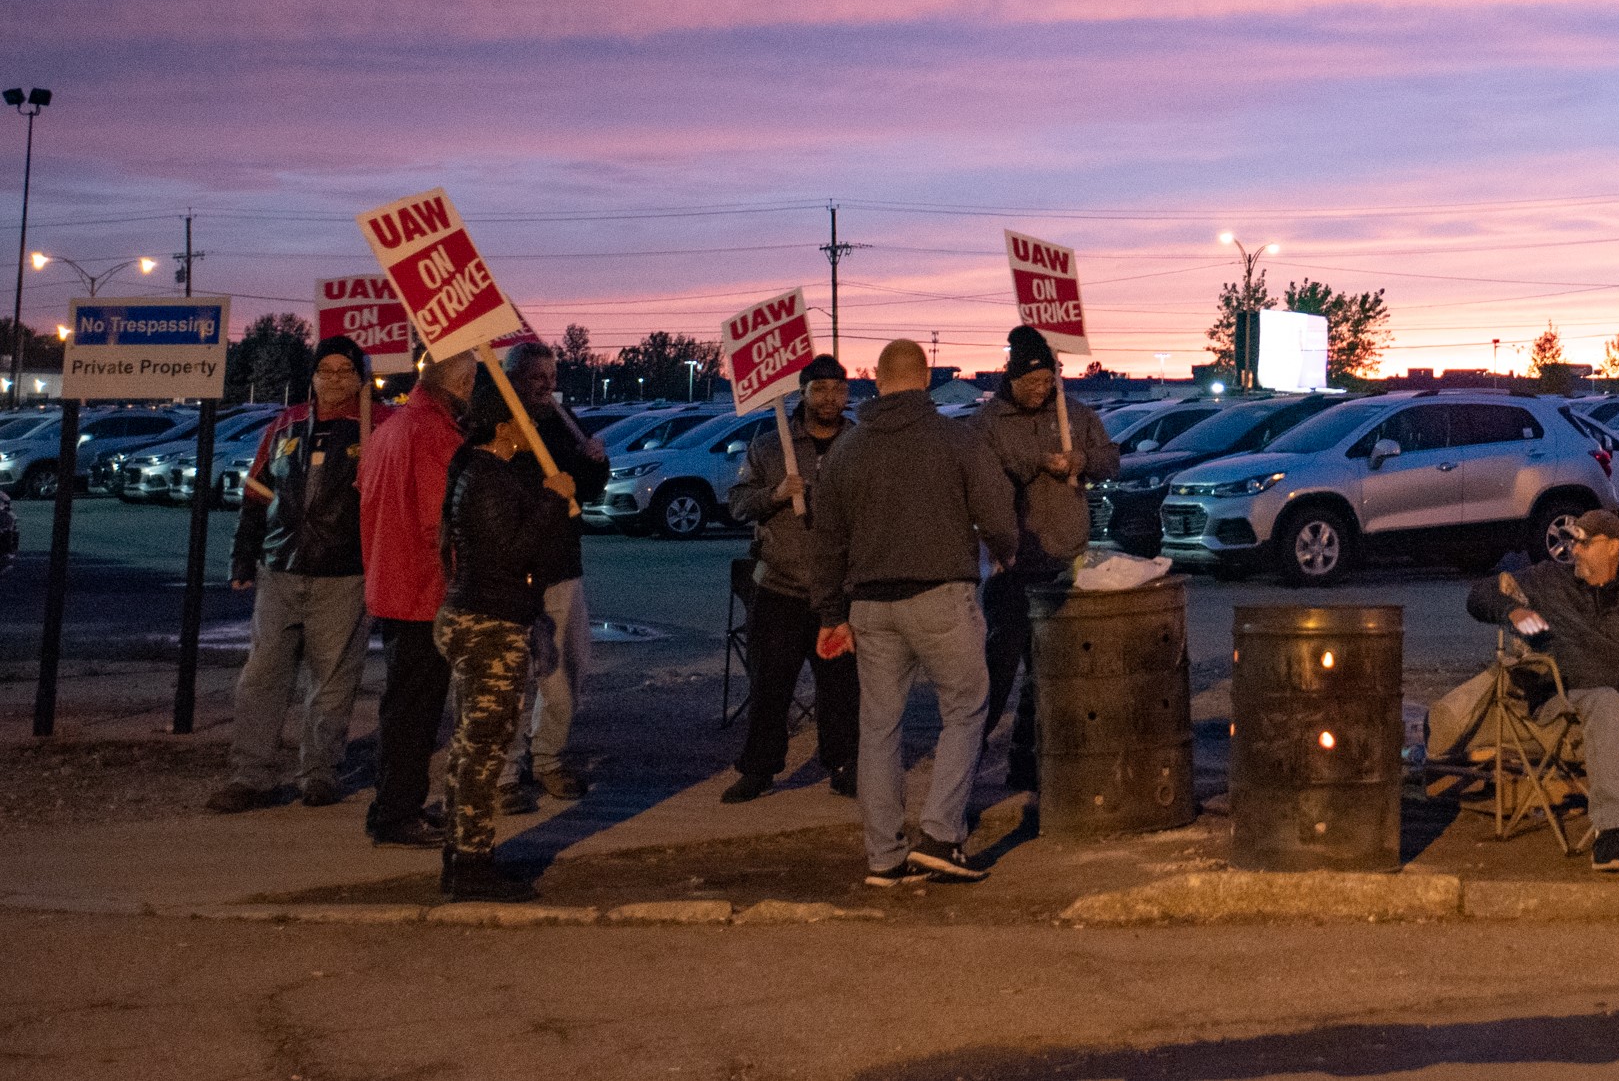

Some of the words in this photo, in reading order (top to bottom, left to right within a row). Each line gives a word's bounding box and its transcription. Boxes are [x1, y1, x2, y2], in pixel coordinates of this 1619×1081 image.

[368, 196, 452, 249] UAW
[417, 244, 456, 289] ON
[1012, 237, 1069, 274] UAW
[416, 257, 493, 340] STRIKE
[1032, 278, 1057, 300] ON
[80, 317, 104, 333] No
[111, 316, 215, 336] Trespassing
[343, 306, 379, 330] ON
[730, 295, 796, 340] UAW
[1020, 300, 1082, 325] STRIKE
[344, 321, 408, 348] RIKE
[752, 329, 782, 363] ON
[72, 360, 134, 375] Private
[140, 359, 217, 377] Property
[737, 333, 808, 398] STRIKE
